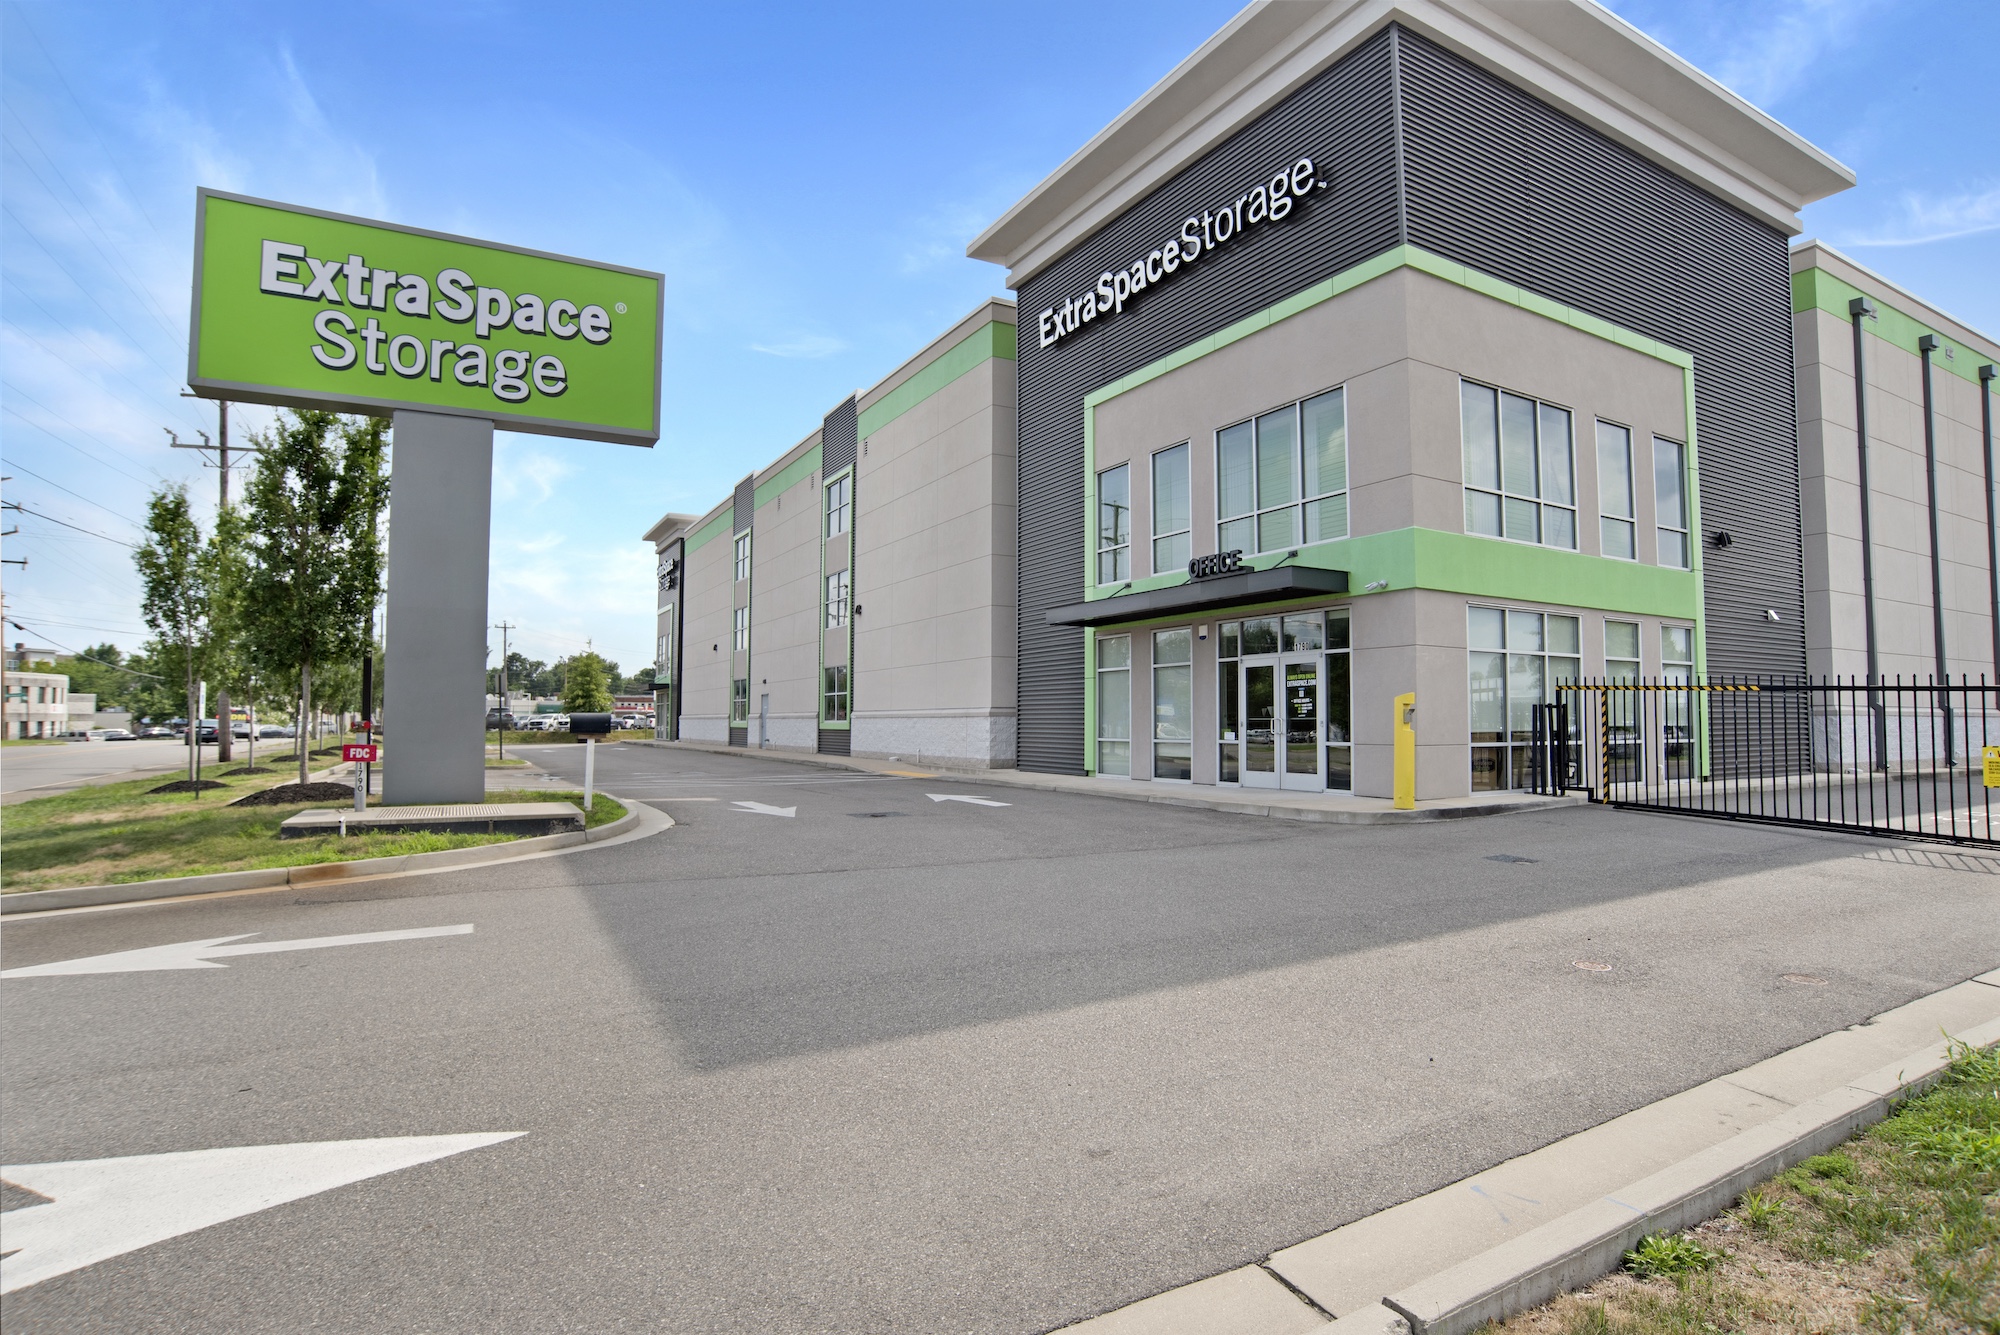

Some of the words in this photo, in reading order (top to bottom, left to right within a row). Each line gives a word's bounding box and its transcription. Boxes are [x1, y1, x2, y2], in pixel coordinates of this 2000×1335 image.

[310, 310, 568, 403] Storage
[1188, 549, 1243, 578] OFFICE
[349, 747, 370, 759] FDC
